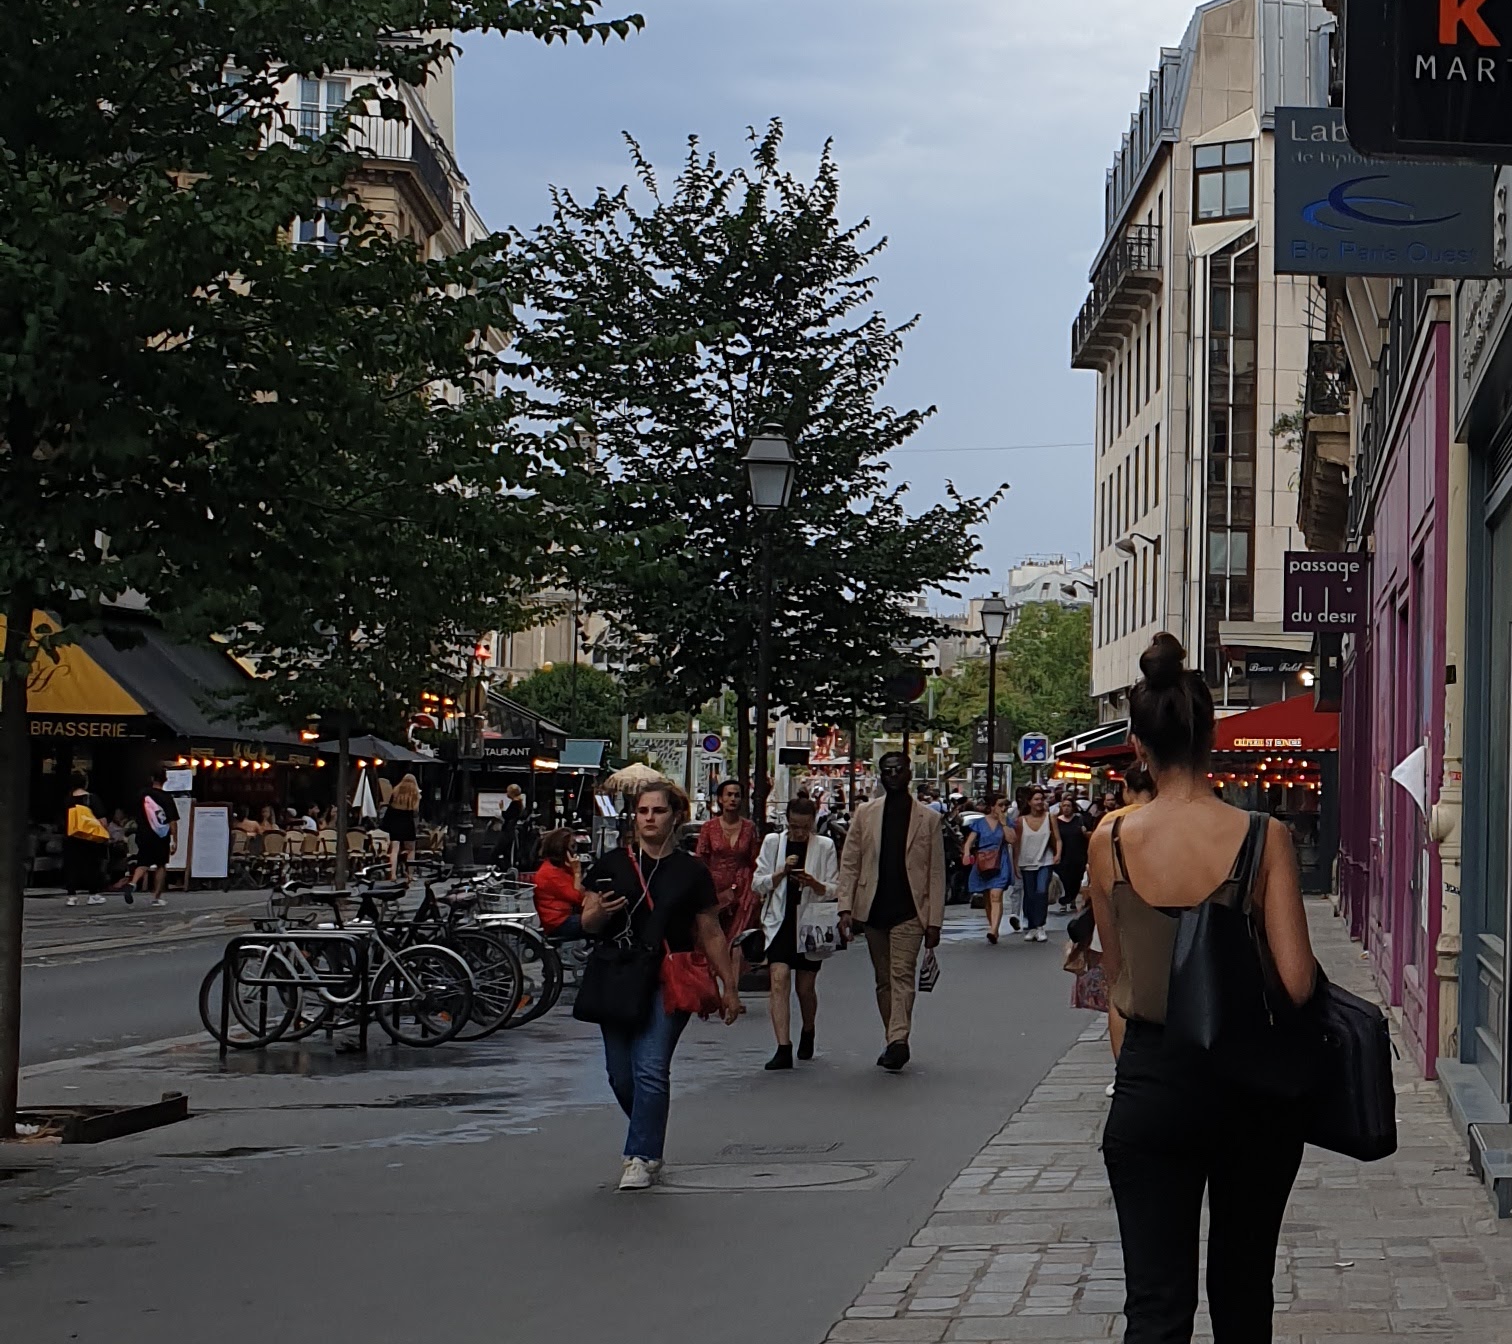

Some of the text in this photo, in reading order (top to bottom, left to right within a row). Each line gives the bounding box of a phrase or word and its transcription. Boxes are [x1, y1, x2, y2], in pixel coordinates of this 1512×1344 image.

[1290, 239, 1330, 261] Bio
[1339, 240, 1397, 263] Paris
[1289, 560, 1360, 582] passage
[1291, 586, 1313, 623] du
[30, 720, 129, 738] BRASSERIE
[484, 747, 531, 757] TAURANT
